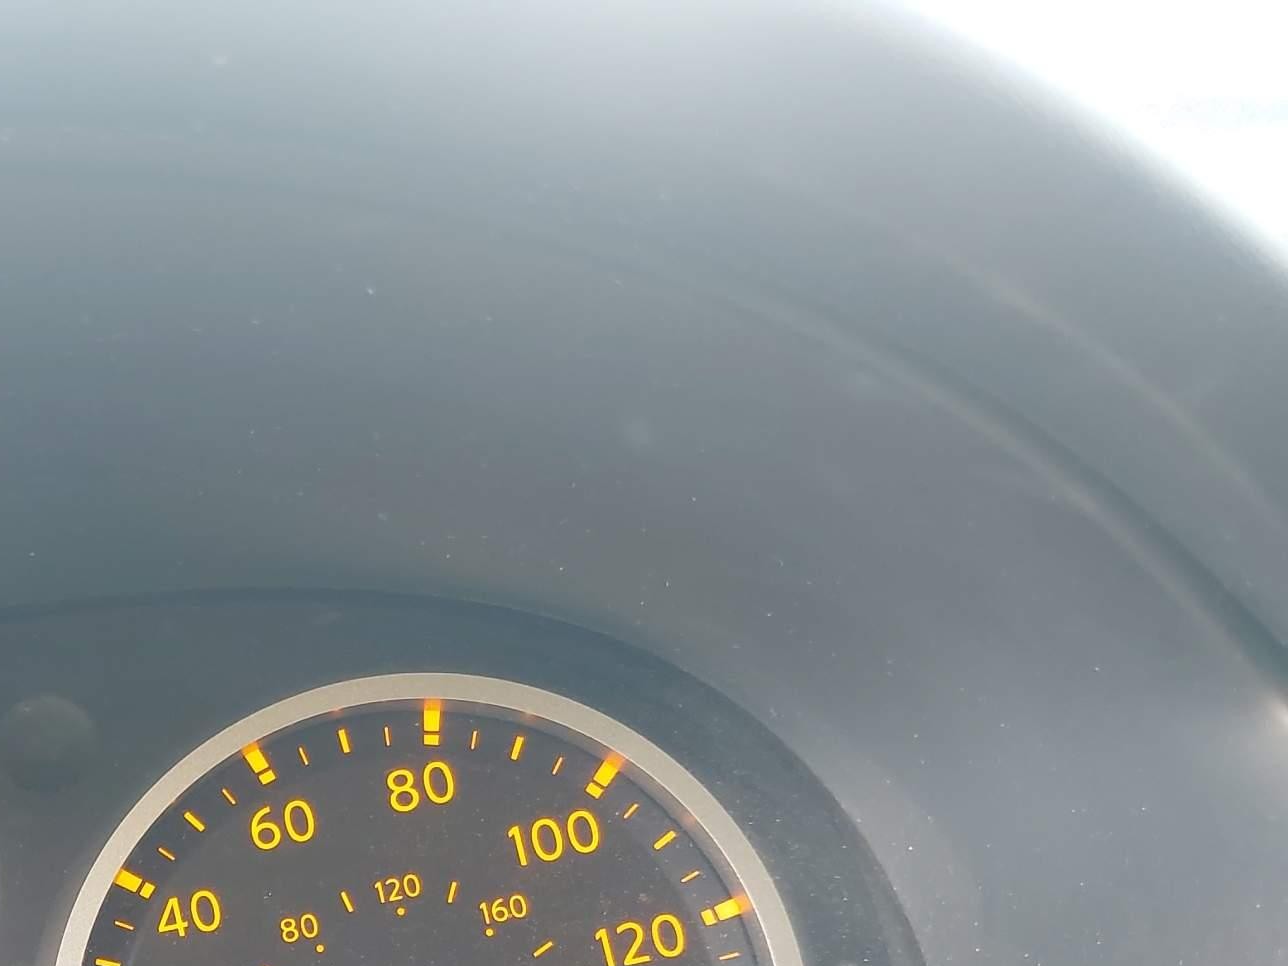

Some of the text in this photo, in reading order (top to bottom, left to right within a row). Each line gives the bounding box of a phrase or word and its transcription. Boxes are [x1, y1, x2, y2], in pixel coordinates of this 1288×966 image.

[385, 762, 456, 812] 80
[249, 800, 316, 850] 60
[507, 810, 600, 866] 100
[374, 873, 421, 905] 120
[479, 894, 528, 926] 160
[157, 890, 221, 938] 40
[280, 913, 319, 943] 80
